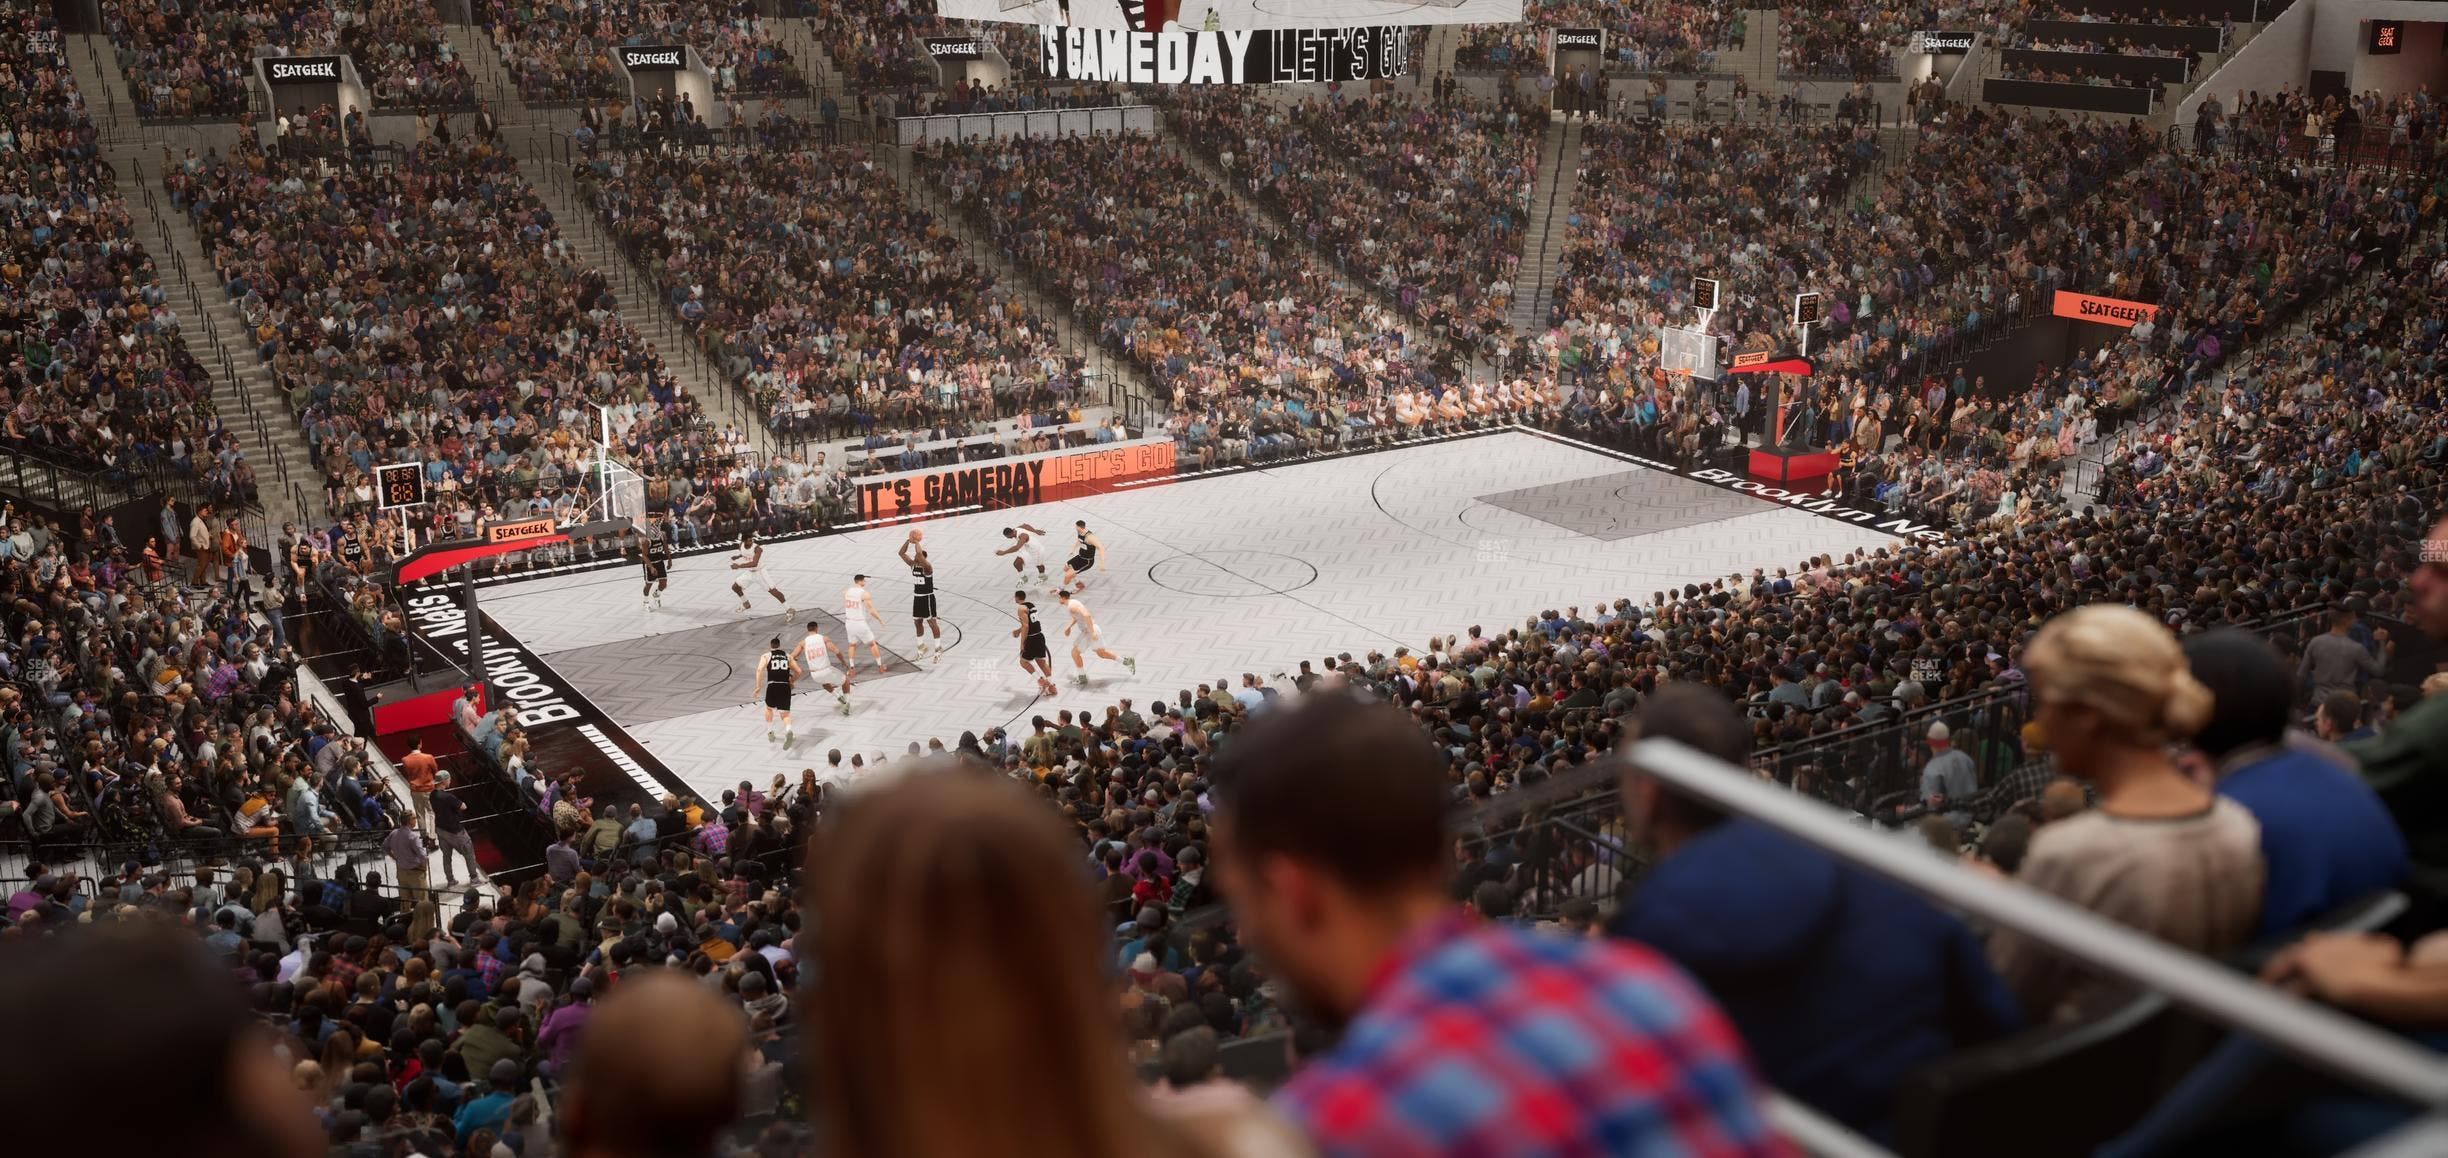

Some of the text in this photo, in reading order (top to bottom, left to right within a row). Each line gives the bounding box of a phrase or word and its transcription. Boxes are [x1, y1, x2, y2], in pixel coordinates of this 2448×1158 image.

[1557, 34, 1598, 45] SEATGEEK
[2380, 27, 2395, 37] SEAT
[930, 42, 976, 55] SEATGEEK
[1924, 38, 1971, 48] SEATGEEK
[2378, 36, 2394, 47] GEEK
[627, 51, 680, 66] SEATGEEK
[1066, 25, 1254, 84] GAMEDAY
[1271, 26, 1369, 83] LET'S
[273, 62, 336, 78] SEATGEEK
[857, 441, 1175, 512] IT'S GAMEDAY LET'S GO!
[1689, 468, 1947, 546] Brooklyn Ne
[496, 522, 549, 540] SEATGEEK
[771, 660, 788, 670] 00
